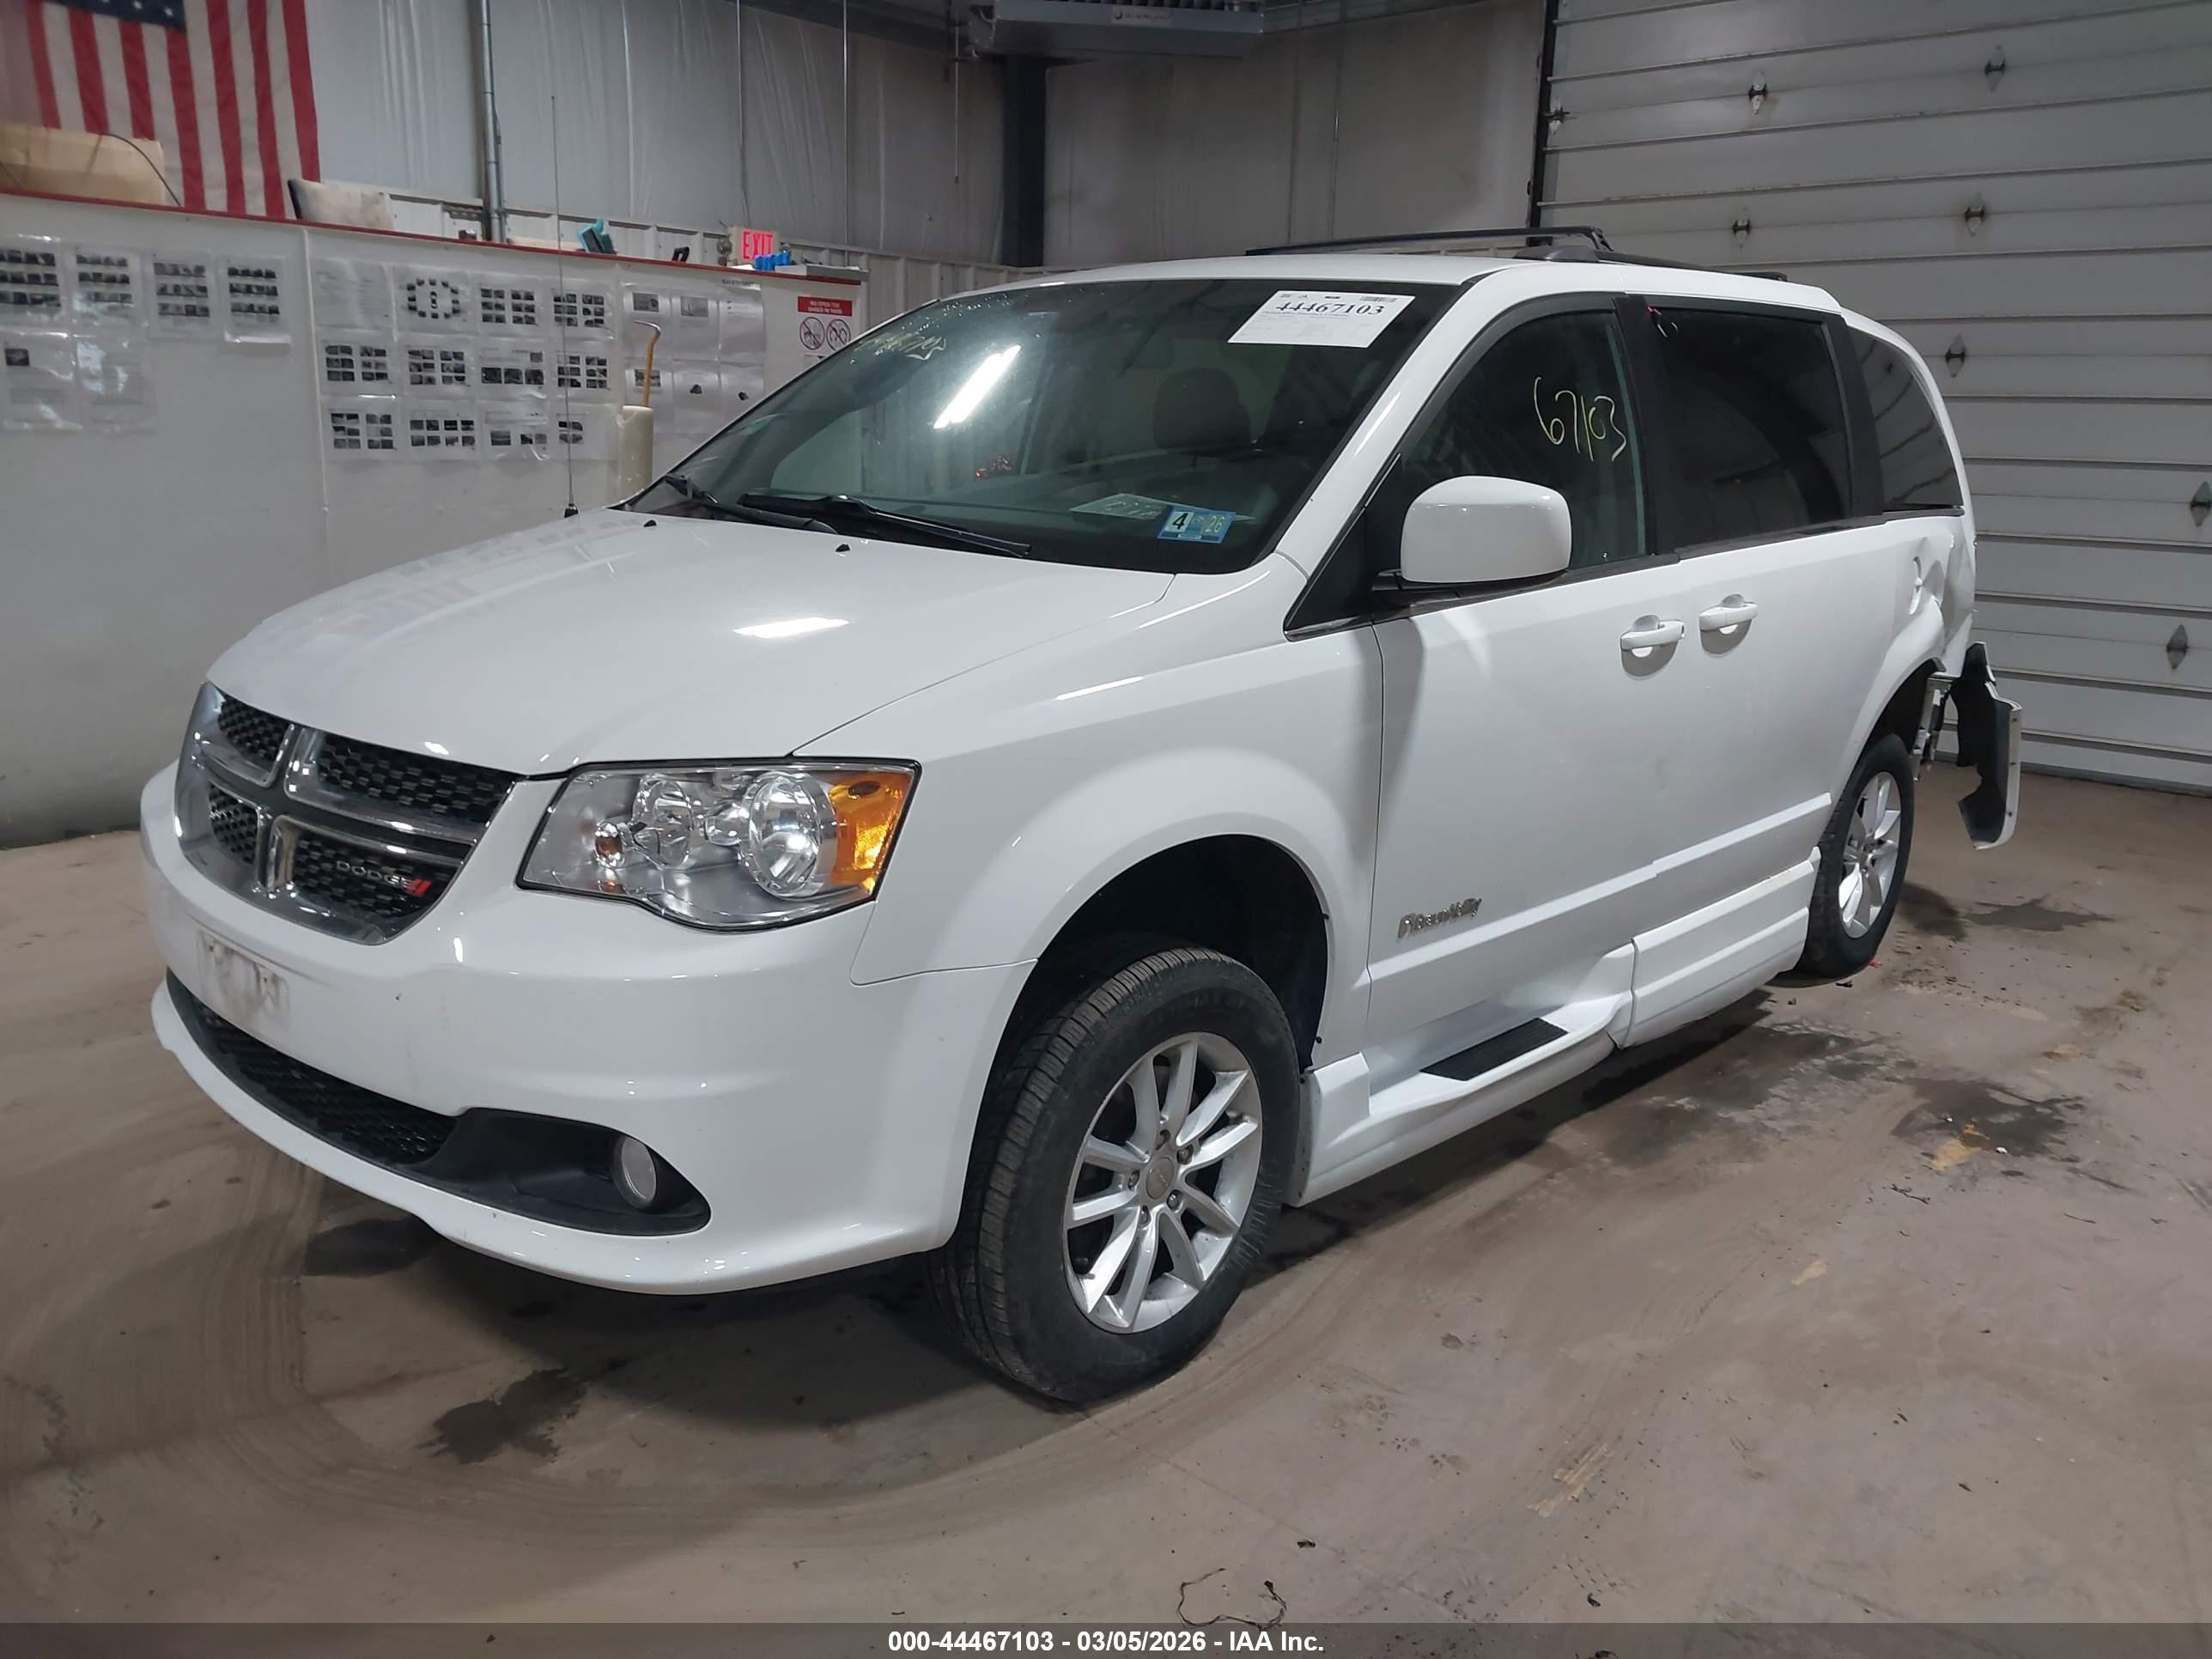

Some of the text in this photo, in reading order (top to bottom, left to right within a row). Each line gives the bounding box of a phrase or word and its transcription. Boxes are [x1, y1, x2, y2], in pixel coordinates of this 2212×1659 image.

[743, 231, 774, 260] EXIT
[1275, 301, 1386, 315] 44467103
[1534, 376, 1627, 462] 67103
[1172, 513, 1225, 533] 4 26
[336, 860, 413, 890] DODGE
